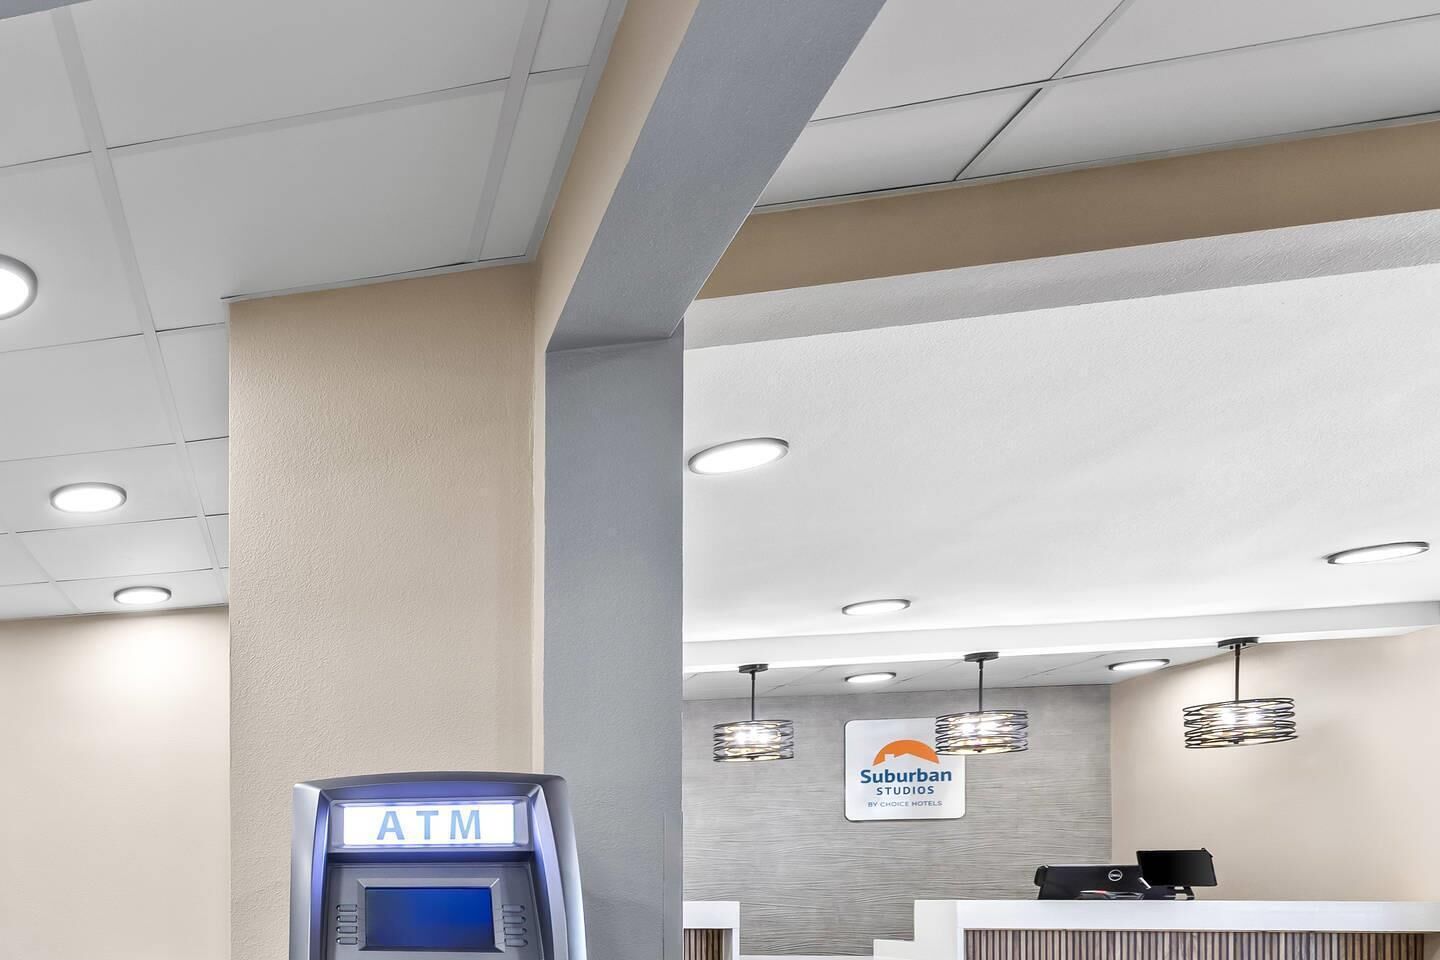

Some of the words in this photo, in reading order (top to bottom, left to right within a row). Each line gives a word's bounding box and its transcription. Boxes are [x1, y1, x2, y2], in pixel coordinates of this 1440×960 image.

[860, 768, 952, 784] Suburban
[876, 786, 935, 796] STUDIOS
[376, 810, 482, 841] ATM
